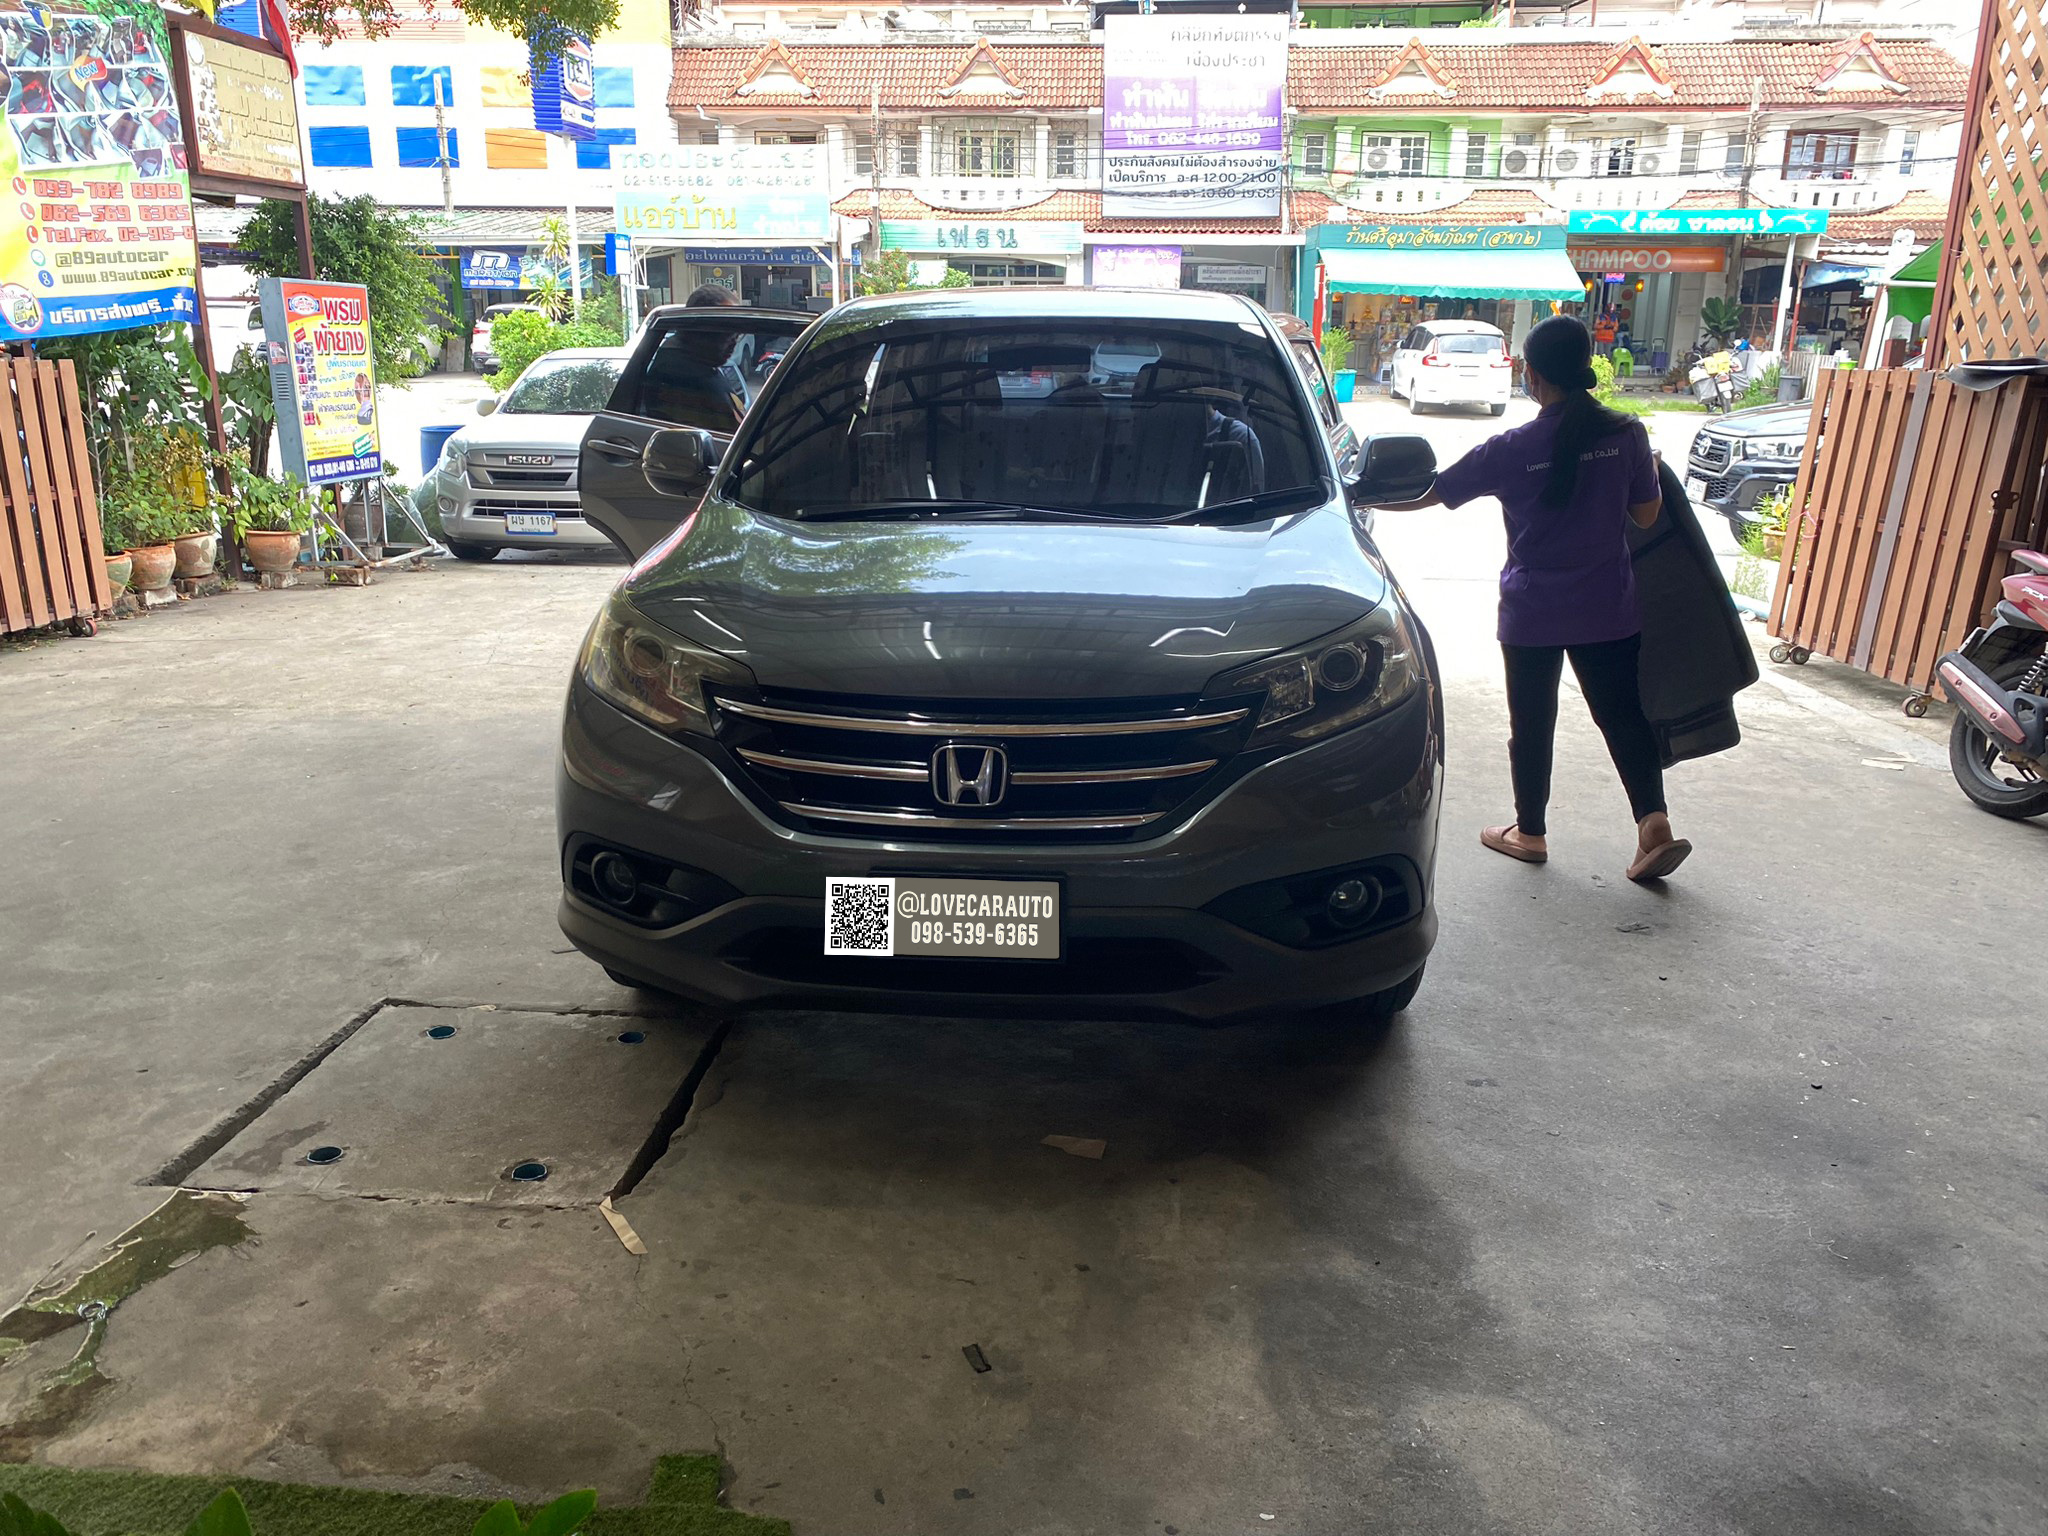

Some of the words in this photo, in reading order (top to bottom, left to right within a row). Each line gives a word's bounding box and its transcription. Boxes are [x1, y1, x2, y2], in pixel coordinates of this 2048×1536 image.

[1109, 155, 1277, 168] ประกันสังคมไม่ต้องสำรองจ่าย
[1109, 170, 1166, 183] เปิดบริการ
[1203, 173, 1276, 183] 12.00-21.00
[33, 179, 124, 199] 093-782
[130, 182, 183, 199] 8989
[41, 203, 131, 221] 062-569
[138, 205, 190, 221] 6365
[623, 194, 737, 229] แอร์บ้าน
[118, 226, 195, 242] 02-915-8
[55, 250, 169, 267] @89autocar
[323, 299, 361, 323] พรม
[314, 323, 366, 354] ผ้ายาง
[508, 455, 552, 465] ISUZU
[530, 516, 552, 525] 1167
